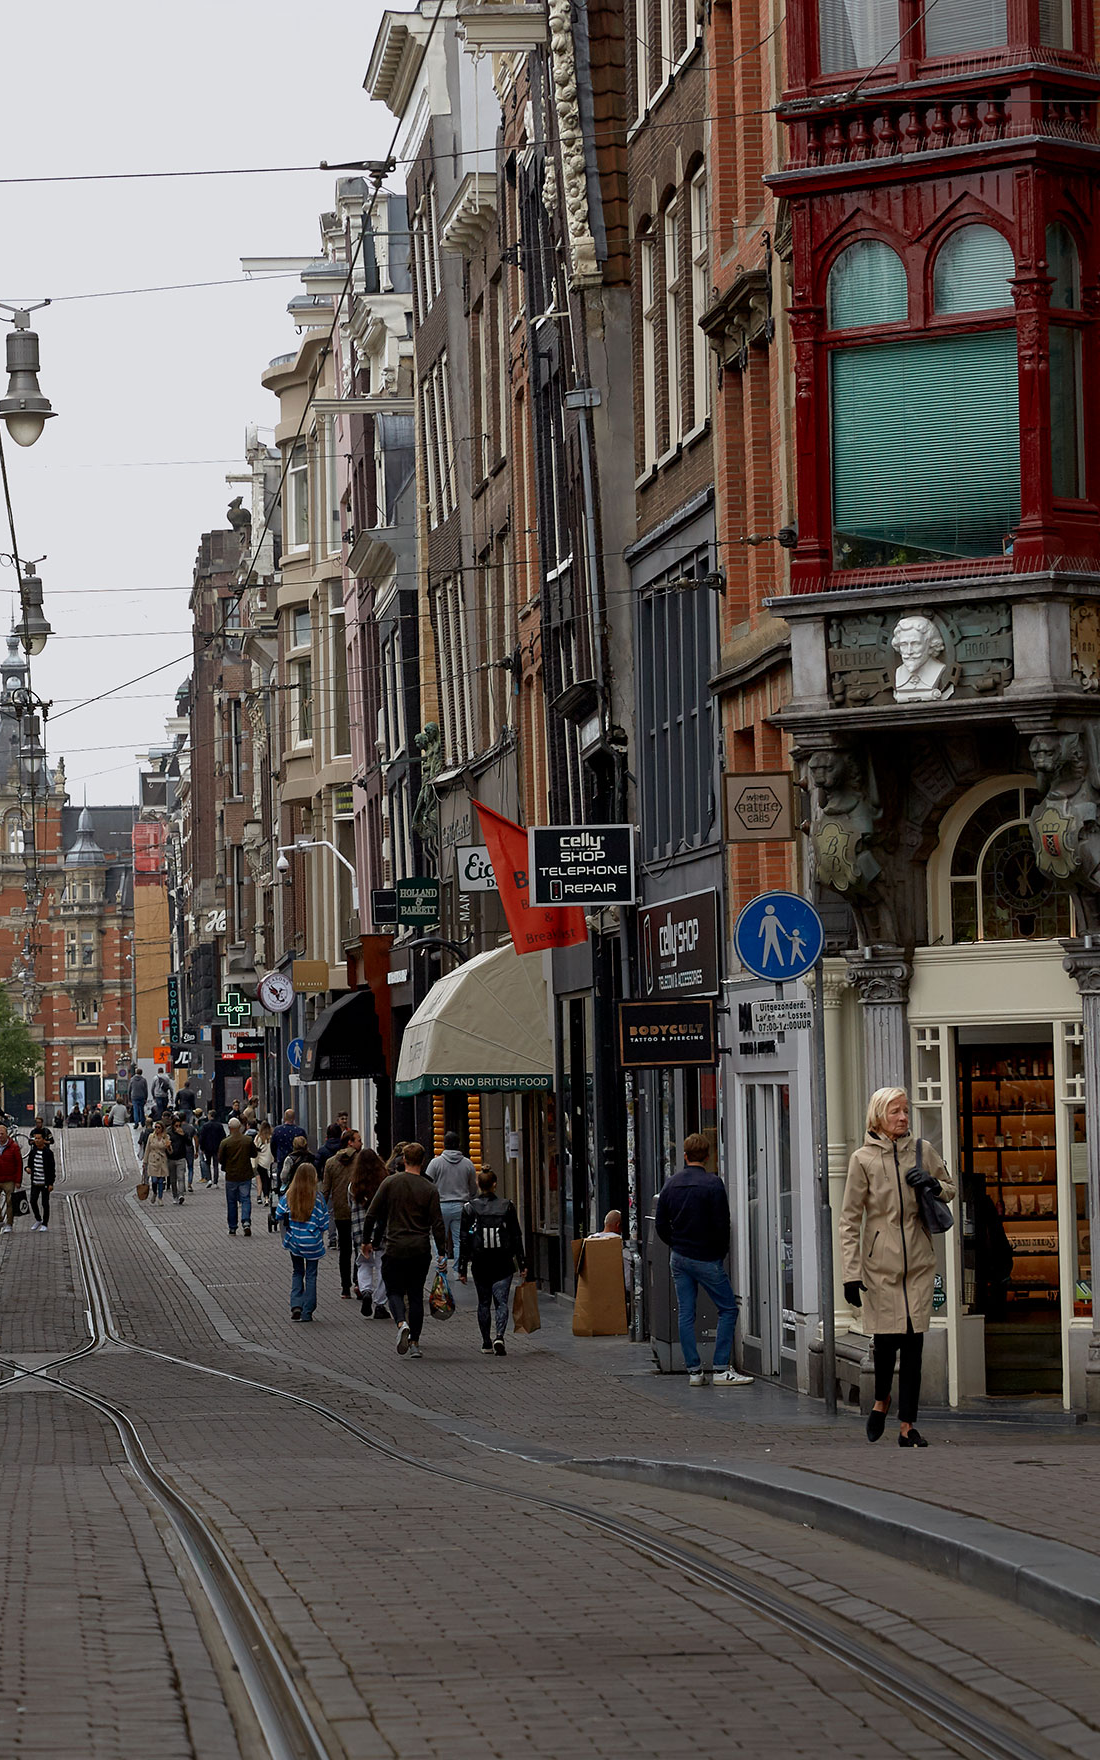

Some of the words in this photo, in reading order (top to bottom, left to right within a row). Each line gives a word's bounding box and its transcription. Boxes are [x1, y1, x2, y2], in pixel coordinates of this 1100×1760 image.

[746, 793, 769, 801] when
[738, 802, 779, 813] nature
[747, 812, 770, 823] calls
[559, 832, 602, 851] celly
[560, 851, 606, 863] SHOP
[464, 853, 495, 881] Eic
[538, 865, 628, 877] TELEPHONE
[399, 888, 438, 898] HOLLAND
[564, 882, 617, 894] REPAIR
[415, 897, 424, 906] &
[400, 905, 437, 915] BARRETT
[459, 894, 470, 922] MAN
[169, 981, 179, 1042] TOPWATC
[787, 1011, 811, 1020] Lossen
[629, 1023, 704, 1036] BODYCULT
[669, 1034, 704, 1042] PIERCING
[432, 1077, 453, 1086] U.S.
[455, 1077, 475, 1086] AND
[477, 1077, 517, 1086] BRITISH
[519, 1077, 549, 1086] FOOD
